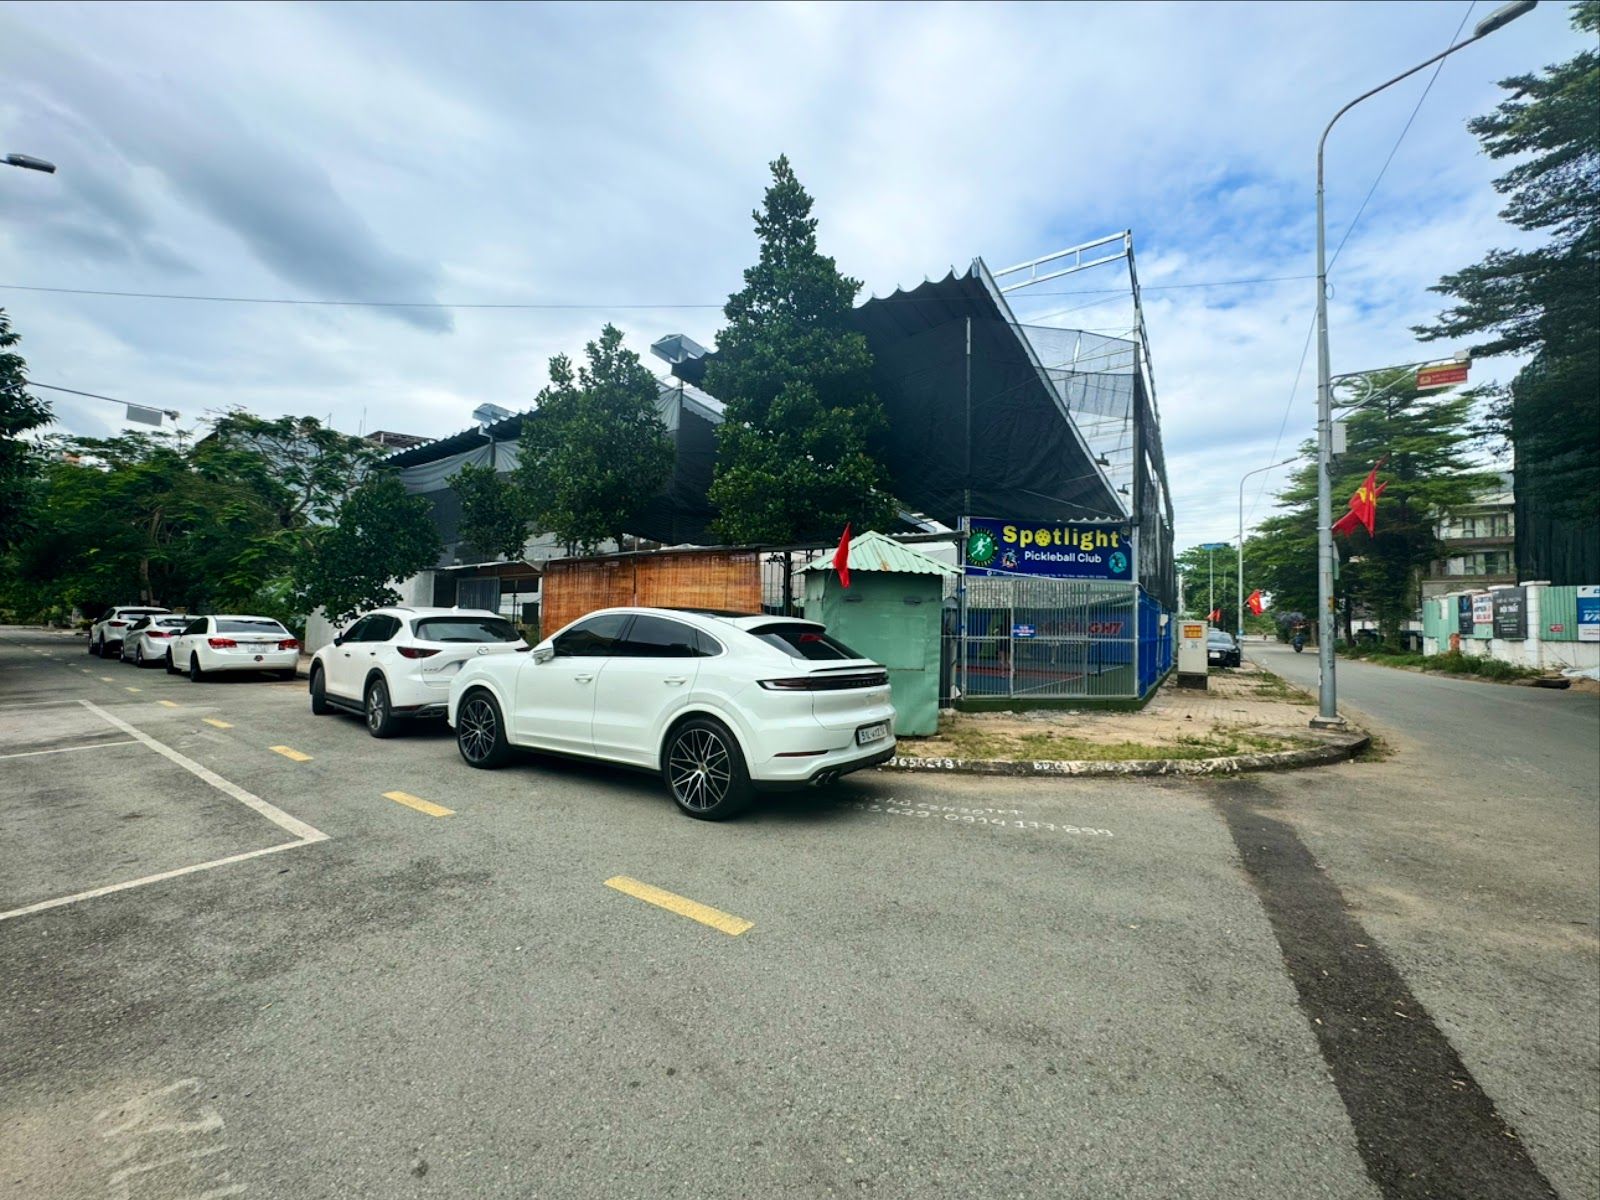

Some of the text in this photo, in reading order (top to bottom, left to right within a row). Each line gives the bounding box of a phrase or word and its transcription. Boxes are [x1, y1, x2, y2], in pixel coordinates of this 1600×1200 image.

[1003, 525, 1119, 551] Spotlight
[1024, 551, 1102, 563] Pickleball Club
